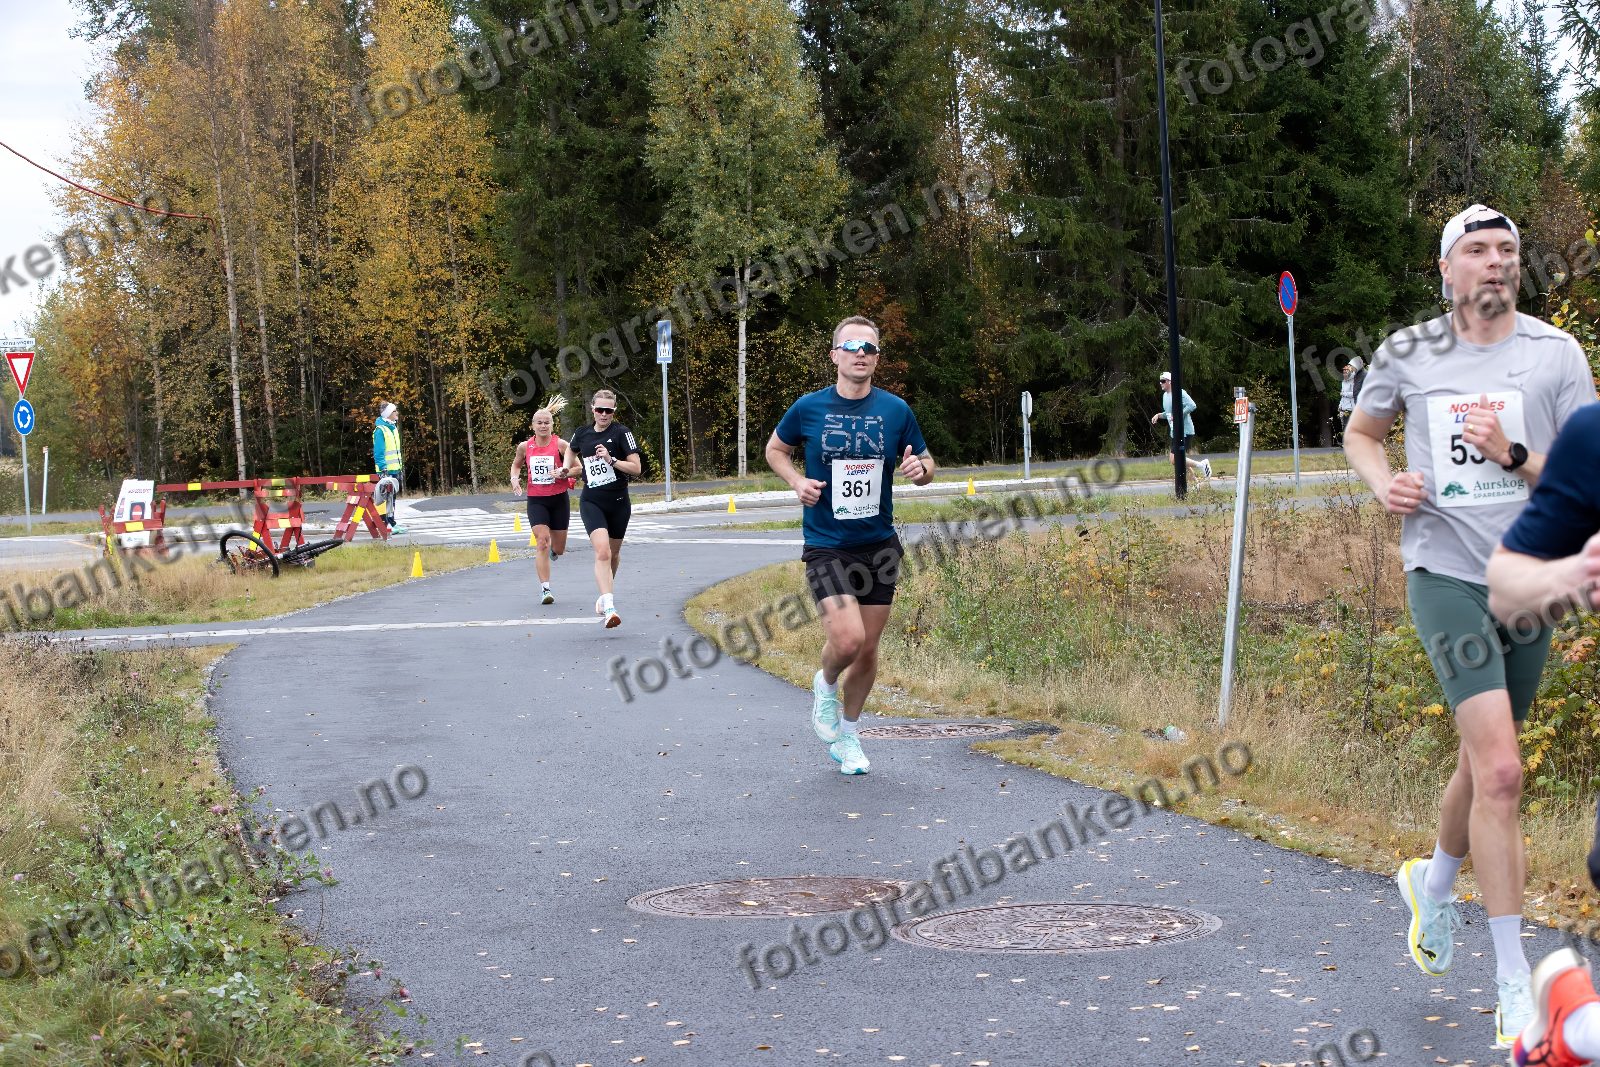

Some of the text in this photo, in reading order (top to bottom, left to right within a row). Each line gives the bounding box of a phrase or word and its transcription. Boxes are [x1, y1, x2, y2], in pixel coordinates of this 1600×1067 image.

[1450, 401, 1505, 413] NOES
[534, 465, 549, 475] 551
[589, 463, 608, 477] 856
[844, 463, 875, 471] NORGES
[841, 479, 871, 498] 361
[1473, 477, 1525, 491] Aurskog
[1473, 490, 1516, 499] SPAREBANK
